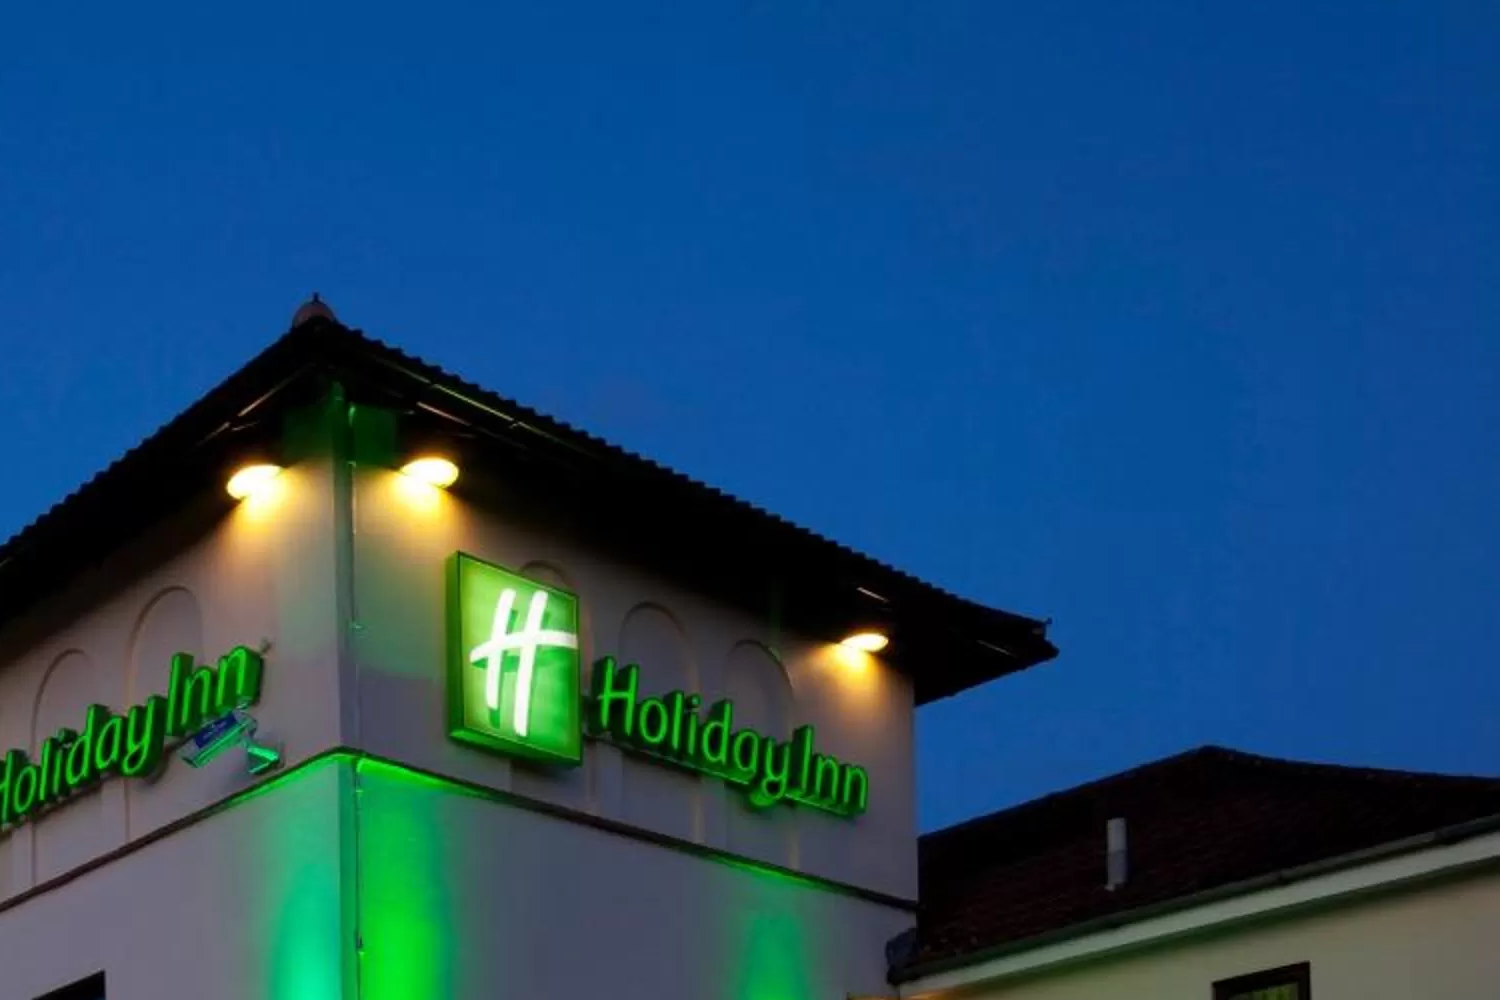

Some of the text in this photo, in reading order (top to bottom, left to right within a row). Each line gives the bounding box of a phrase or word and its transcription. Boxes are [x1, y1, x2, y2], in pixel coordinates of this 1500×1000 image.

[166, 645, 261, 736] Inn
[469, 588, 578, 738] H
[596, 655, 868, 808] Holiday Inn
